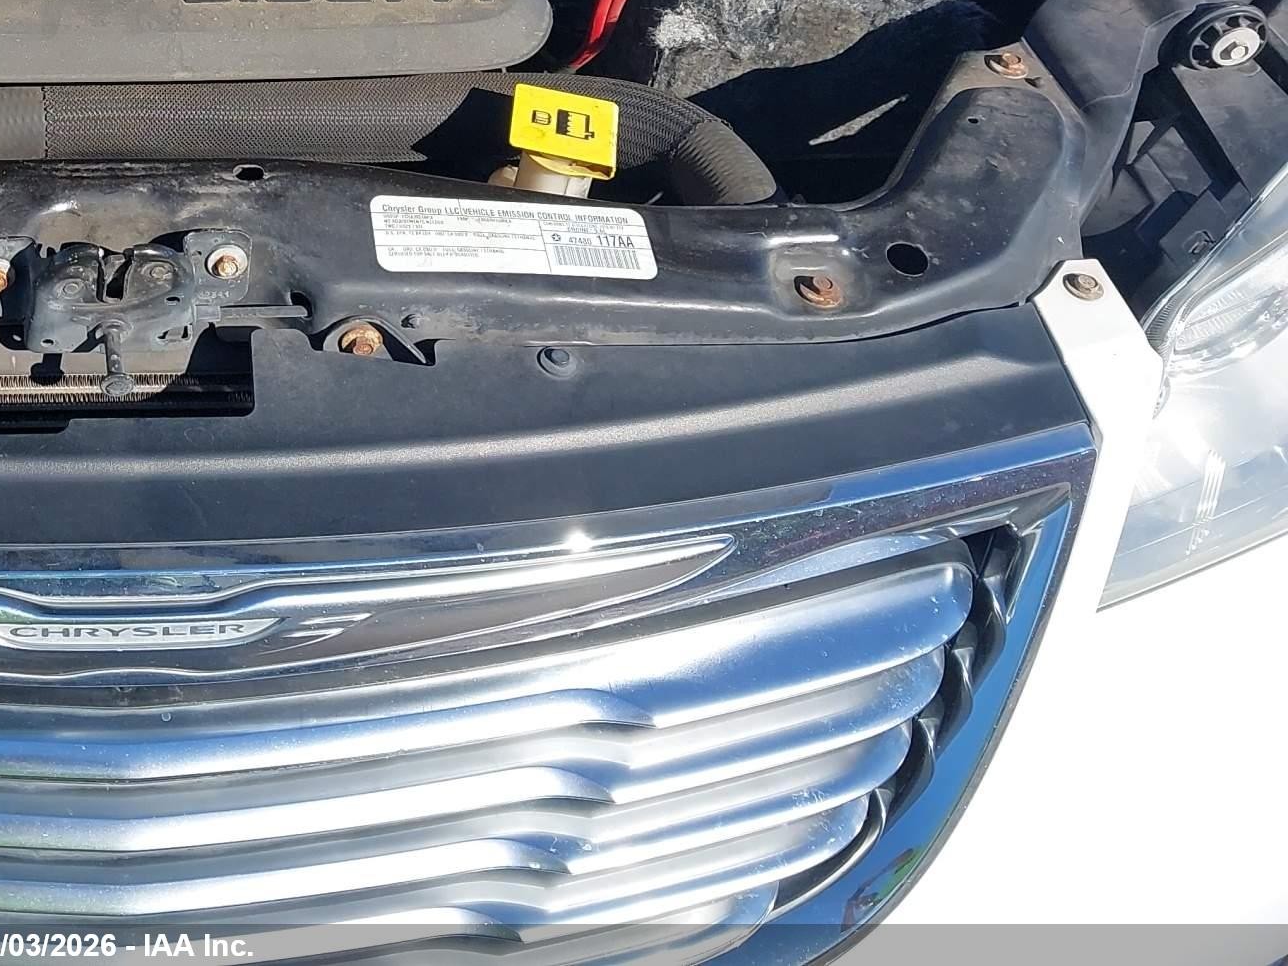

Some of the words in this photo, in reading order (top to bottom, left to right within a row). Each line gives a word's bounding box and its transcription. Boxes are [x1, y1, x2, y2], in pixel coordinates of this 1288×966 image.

[382, 204, 416, 215] Chrysler
[418, 205, 442, 216] Group
[444, 207, 460, 215] LLC
[462, 208, 495, 217] VEHICLE
[497, 209, 535, 219] EMISSION
[537, 211, 571, 221] CONTROL
[575, 214, 629, 224] INFORMATION
[597, 235, 635, 248] 117AA
[9, 623, 245, 639] CHRYSLER
